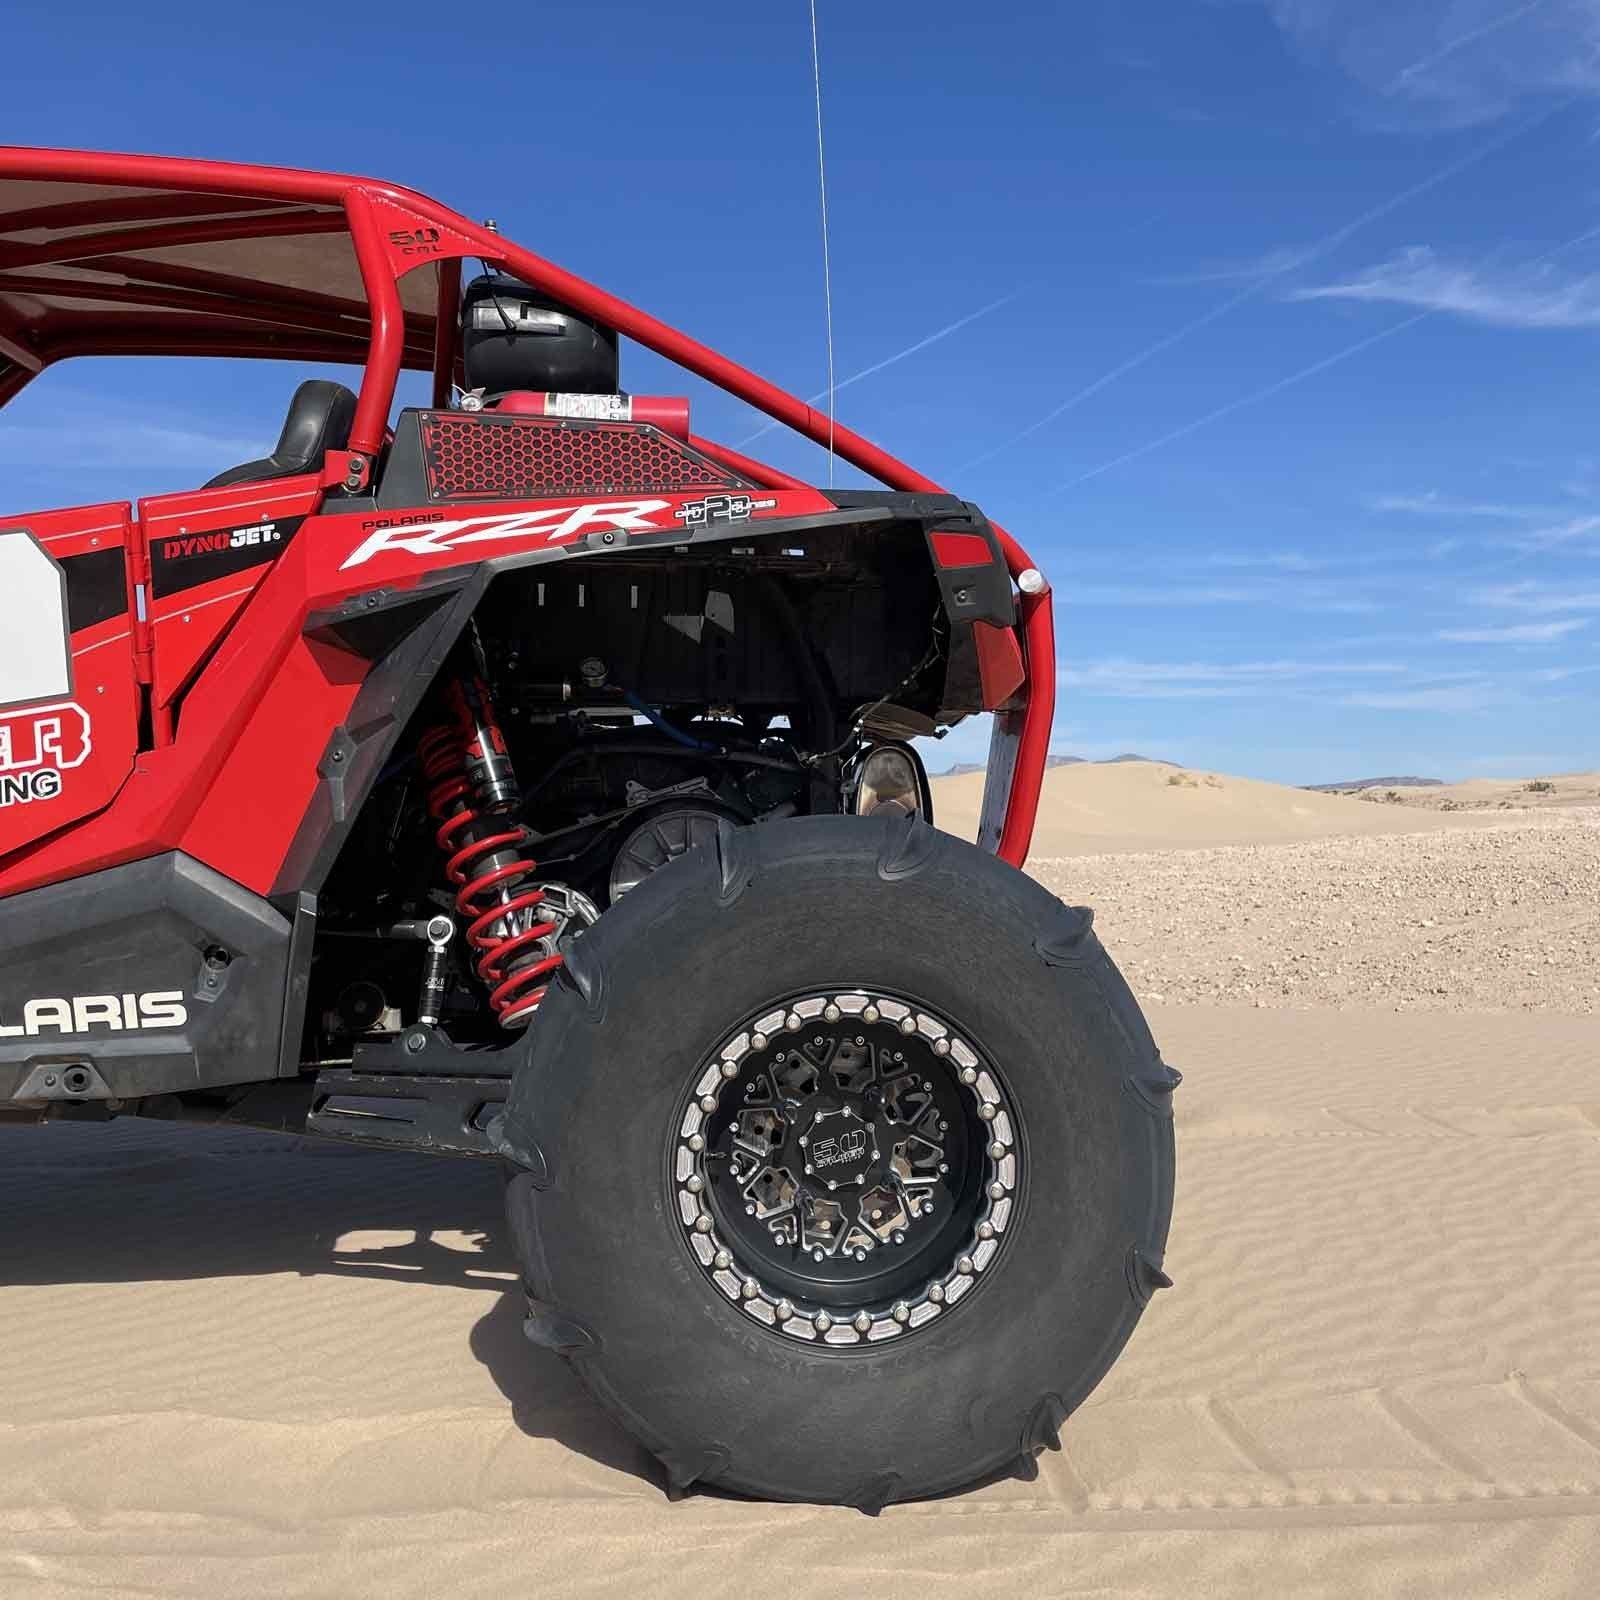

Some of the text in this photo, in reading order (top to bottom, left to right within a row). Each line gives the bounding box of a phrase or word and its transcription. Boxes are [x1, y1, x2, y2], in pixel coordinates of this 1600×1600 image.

[388, 228, 440, 247] 50
[361, 512, 445, 530] POLARIS
[339, 499, 673, 572] RZR
